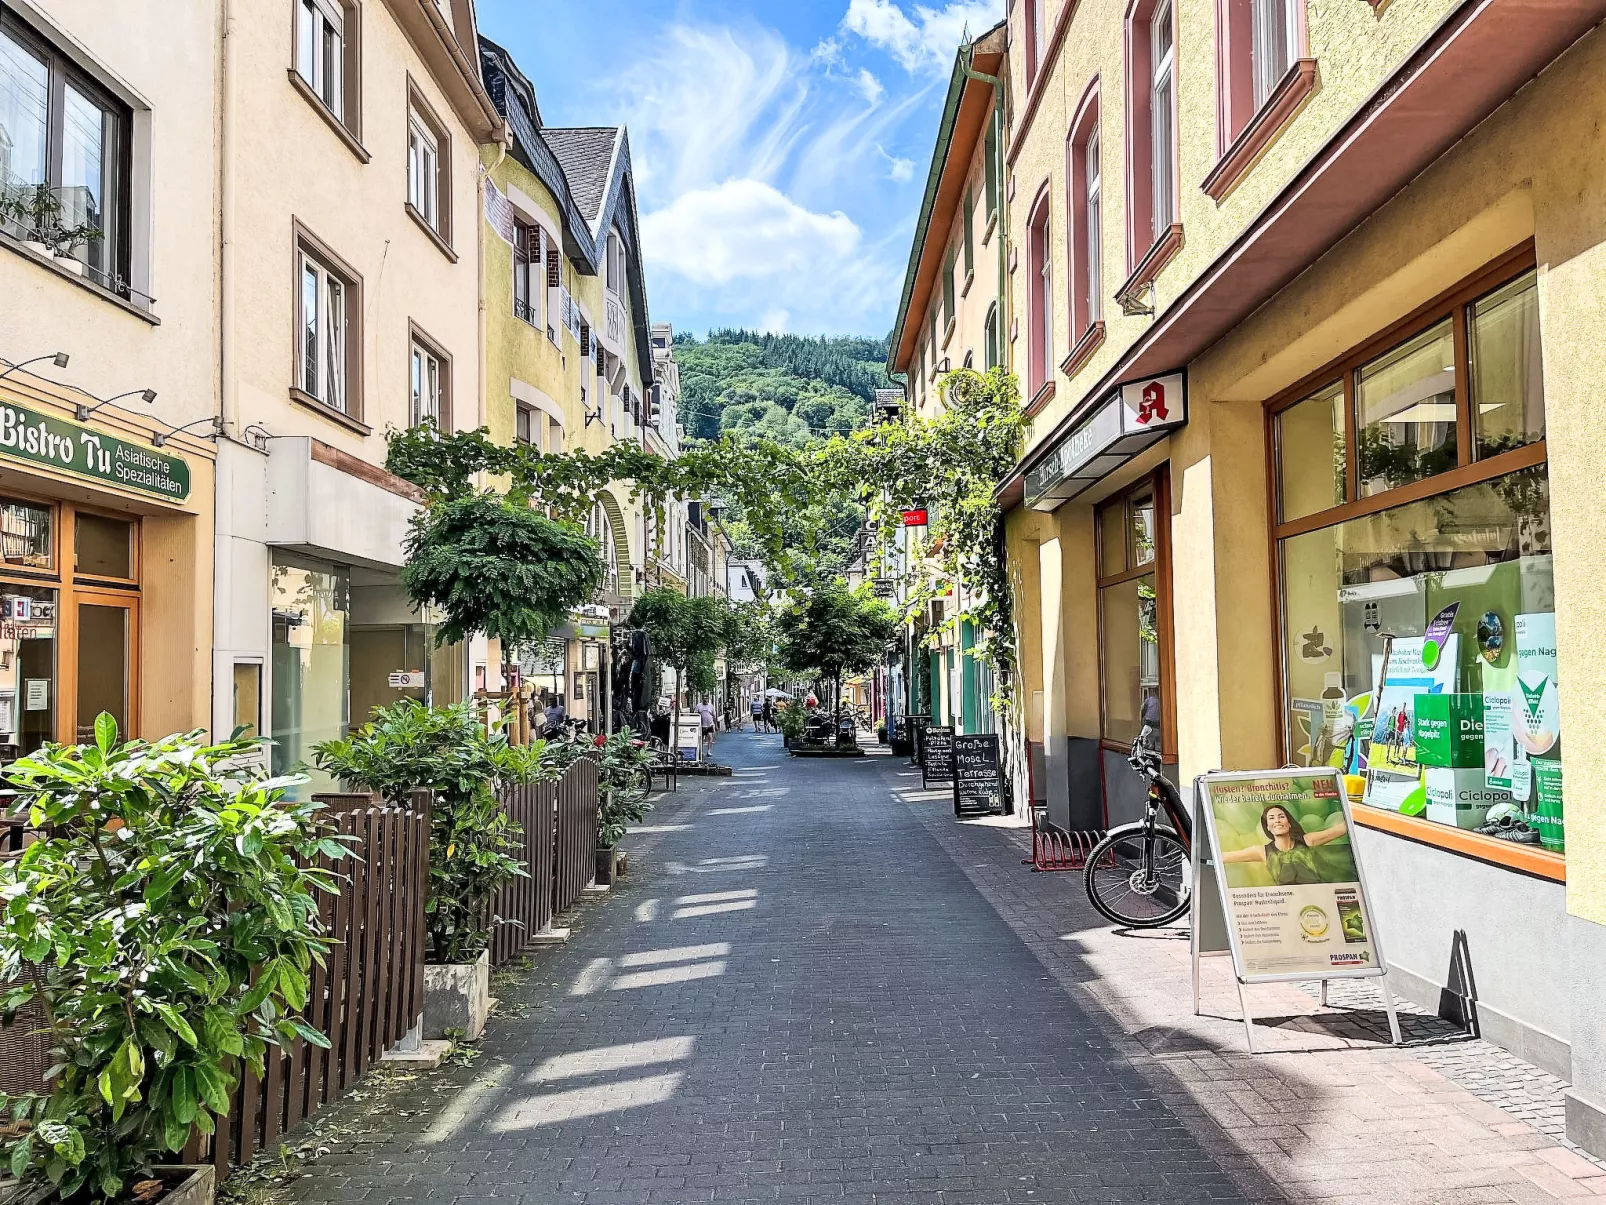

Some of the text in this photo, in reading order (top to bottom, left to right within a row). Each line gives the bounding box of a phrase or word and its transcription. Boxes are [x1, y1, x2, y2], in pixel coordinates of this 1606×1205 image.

[0, 406, 111, 474] Bistro Tu
[115, 444, 170, 474] Asiatische
[115, 462, 182, 494] Spezialitäten
[1430, 719, 1447, 728] gegen
[1460, 716, 1483, 730] Die
[957, 769, 997, 778] Terrasse
[1247, 782, 1289, 792] Bronchitis?
[1312, 780, 1334, 790] NEU
[1427, 785, 1453, 800] Ciclopoli
[1215, 795, 1239, 803] Wieder
